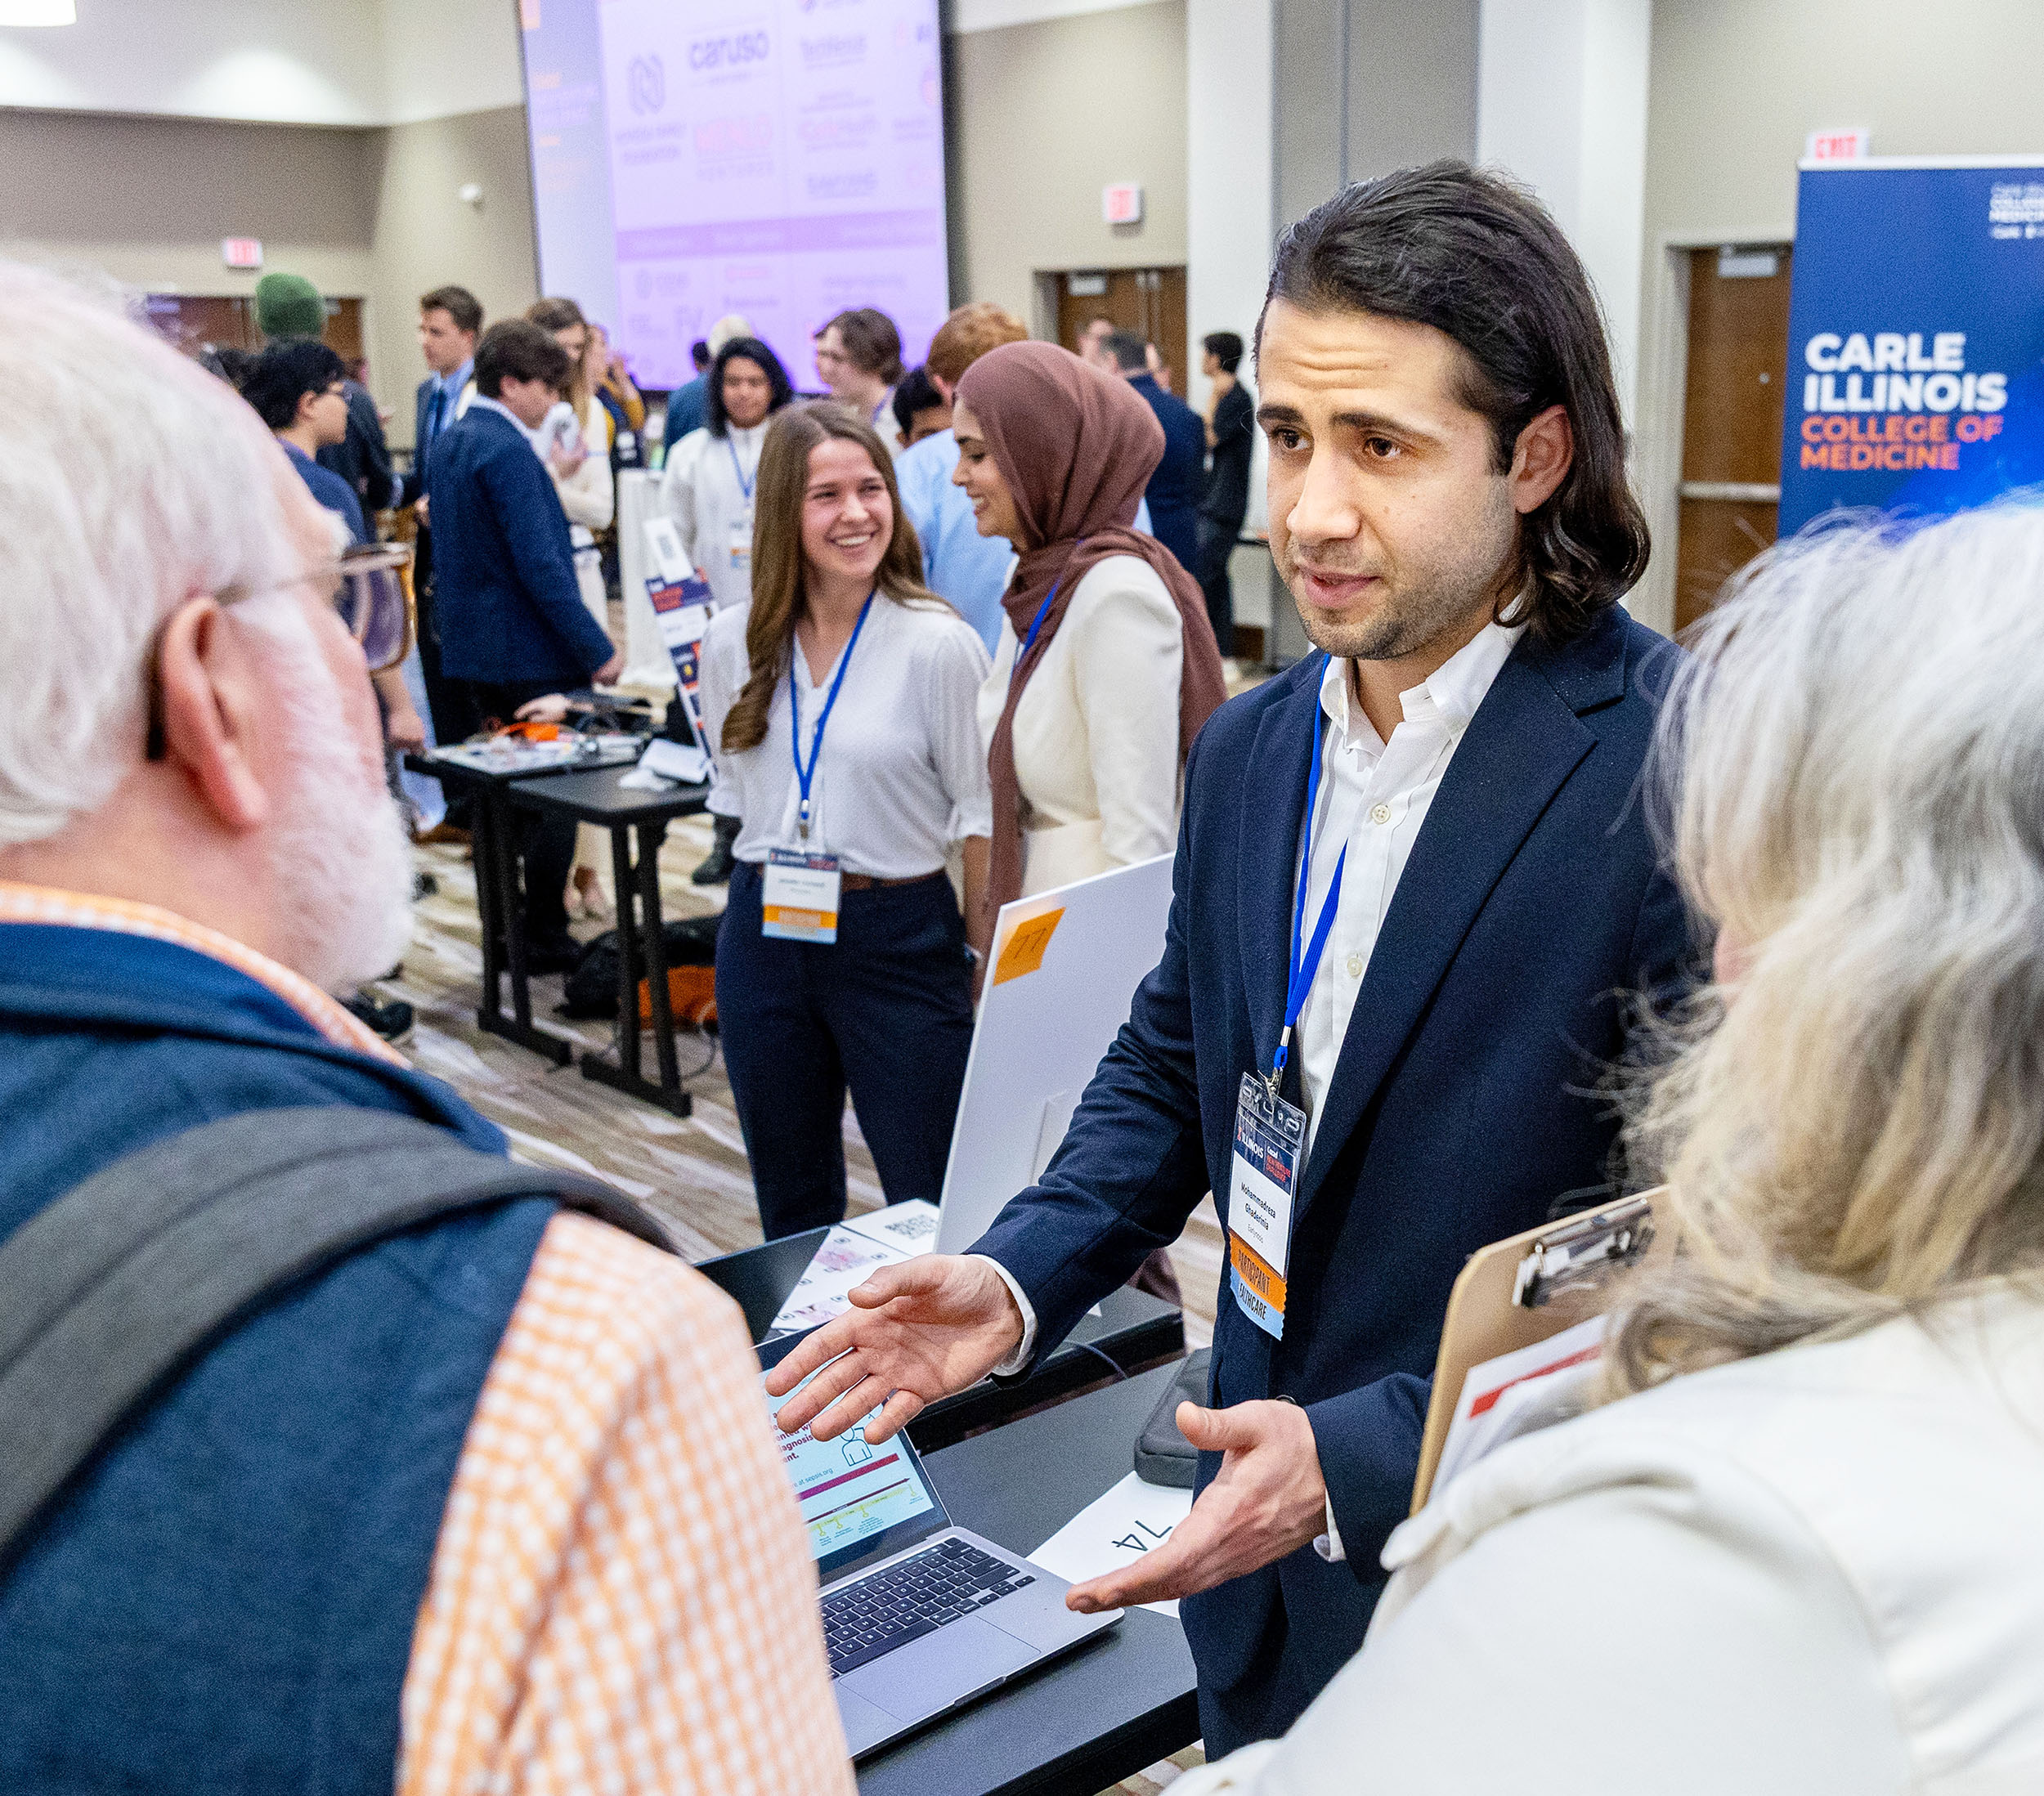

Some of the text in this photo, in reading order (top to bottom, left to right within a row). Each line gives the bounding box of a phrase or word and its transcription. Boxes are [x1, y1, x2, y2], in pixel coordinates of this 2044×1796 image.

[689, 30, 769, 71] caruso
[1804, 333, 1966, 371] CARLE
[1804, 374, 2007, 413] ILLINOIS
[1800, 415, 2004, 442] COLLEGE OF
[1800, 444, 1961, 470] MEDICINE
[1241, 1132, 1264, 1158] ILLINOIS
[1238, 1248, 1271, 1296] PARTICIPANT
[1239, 1283, 1267, 1320] EALTHCARE
[805, 1468, 834, 1482] sepsis.org
[1111, 1519, 1173, 1552] 74
